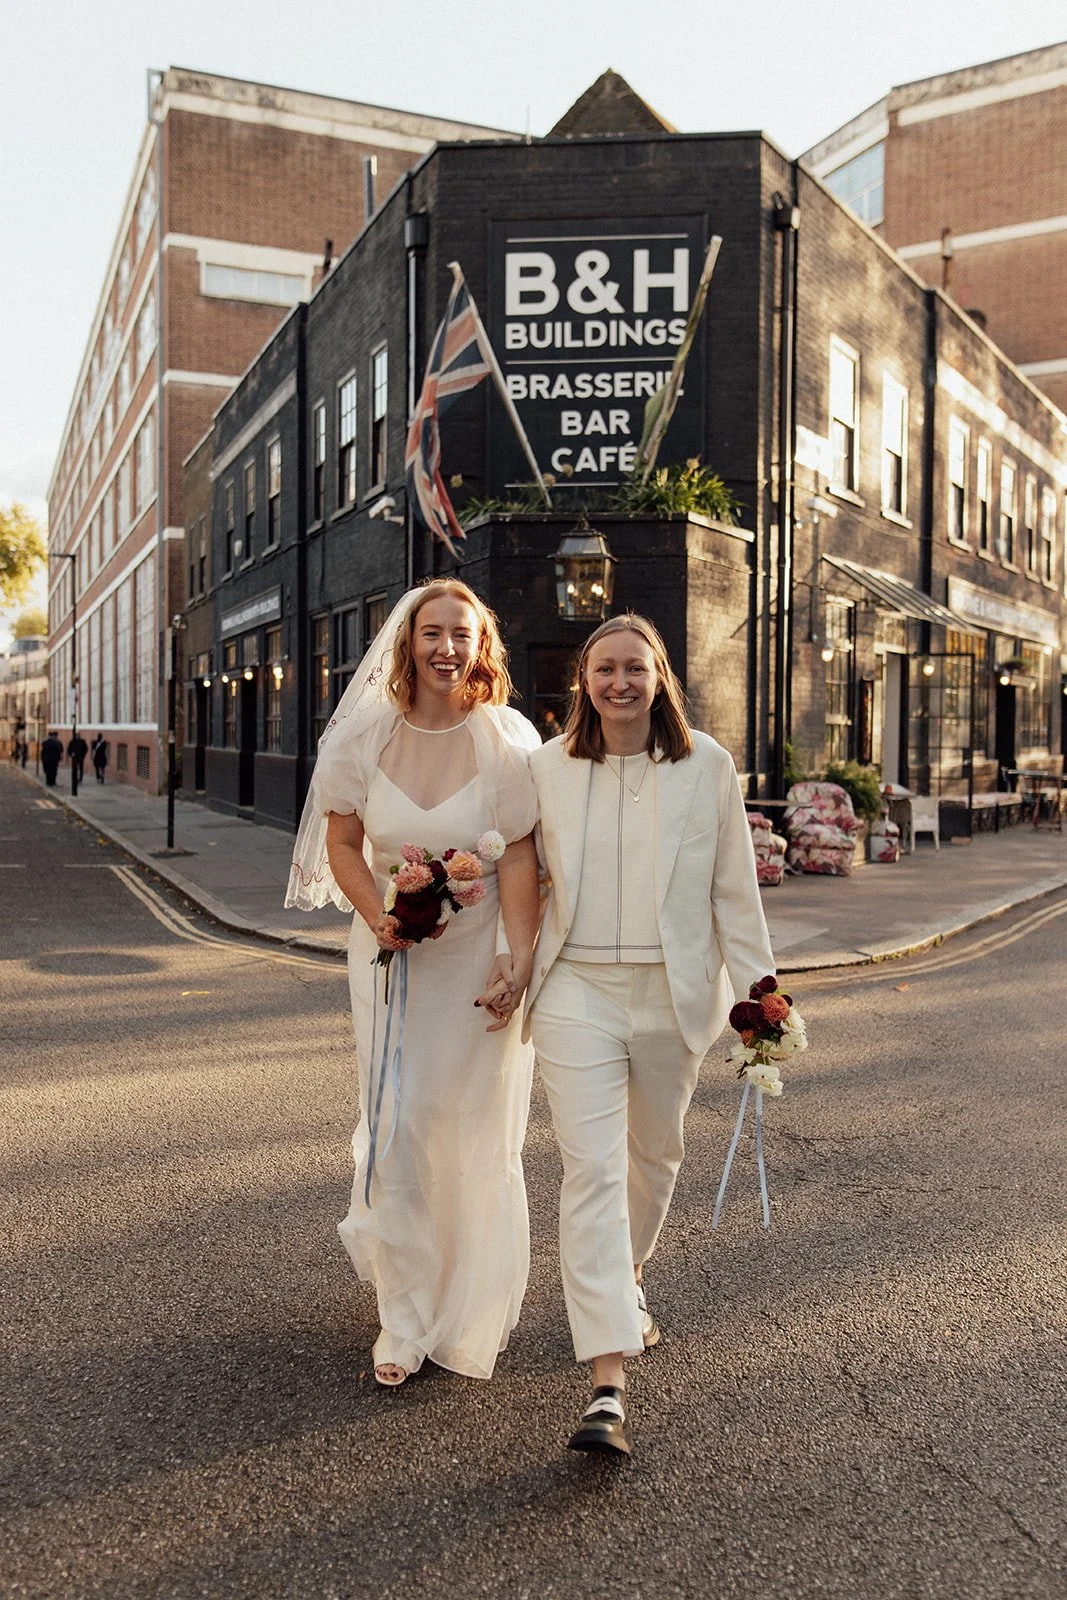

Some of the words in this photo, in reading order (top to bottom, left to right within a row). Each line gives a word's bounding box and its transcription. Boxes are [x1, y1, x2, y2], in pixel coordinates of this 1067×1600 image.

[505, 248, 690, 316] B&H
[505, 318, 689, 350] BUILDINGS
[560, 408, 631, 436] BAR
[551, 441, 638, 473] CAFÉ
